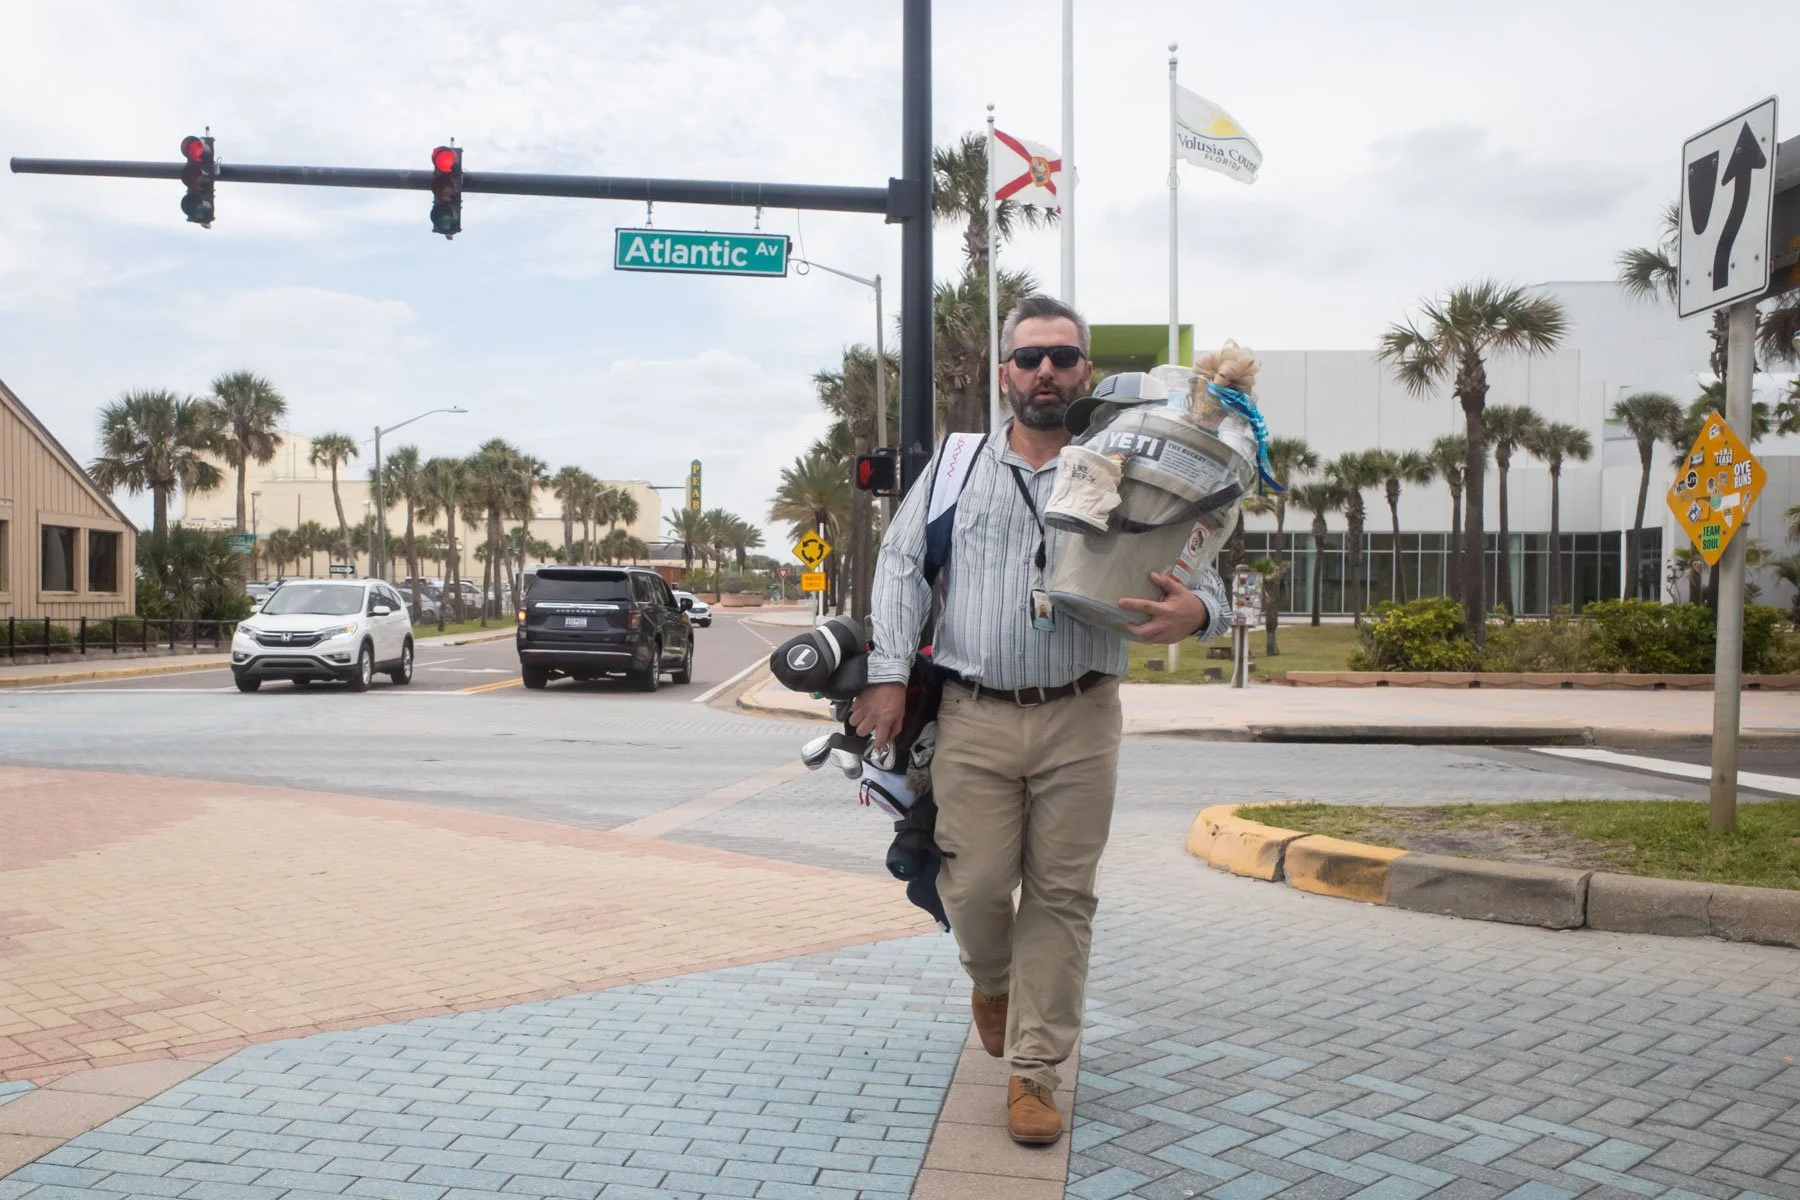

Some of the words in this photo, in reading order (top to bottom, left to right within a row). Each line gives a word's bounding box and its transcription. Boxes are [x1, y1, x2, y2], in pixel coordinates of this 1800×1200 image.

[1178, 133, 1225, 156] Volusia
[624, 236, 748, 267] Atlantic
[755, 242, 779, 256] Av
[1108, 432, 1159, 457] YETI
[1734, 460, 1752, 476] OYE
[1734, 473, 1752, 489] RUNS
[1703, 525, 1720, 537] TEAM
[1702, 538, 1719, 550] SOUL
